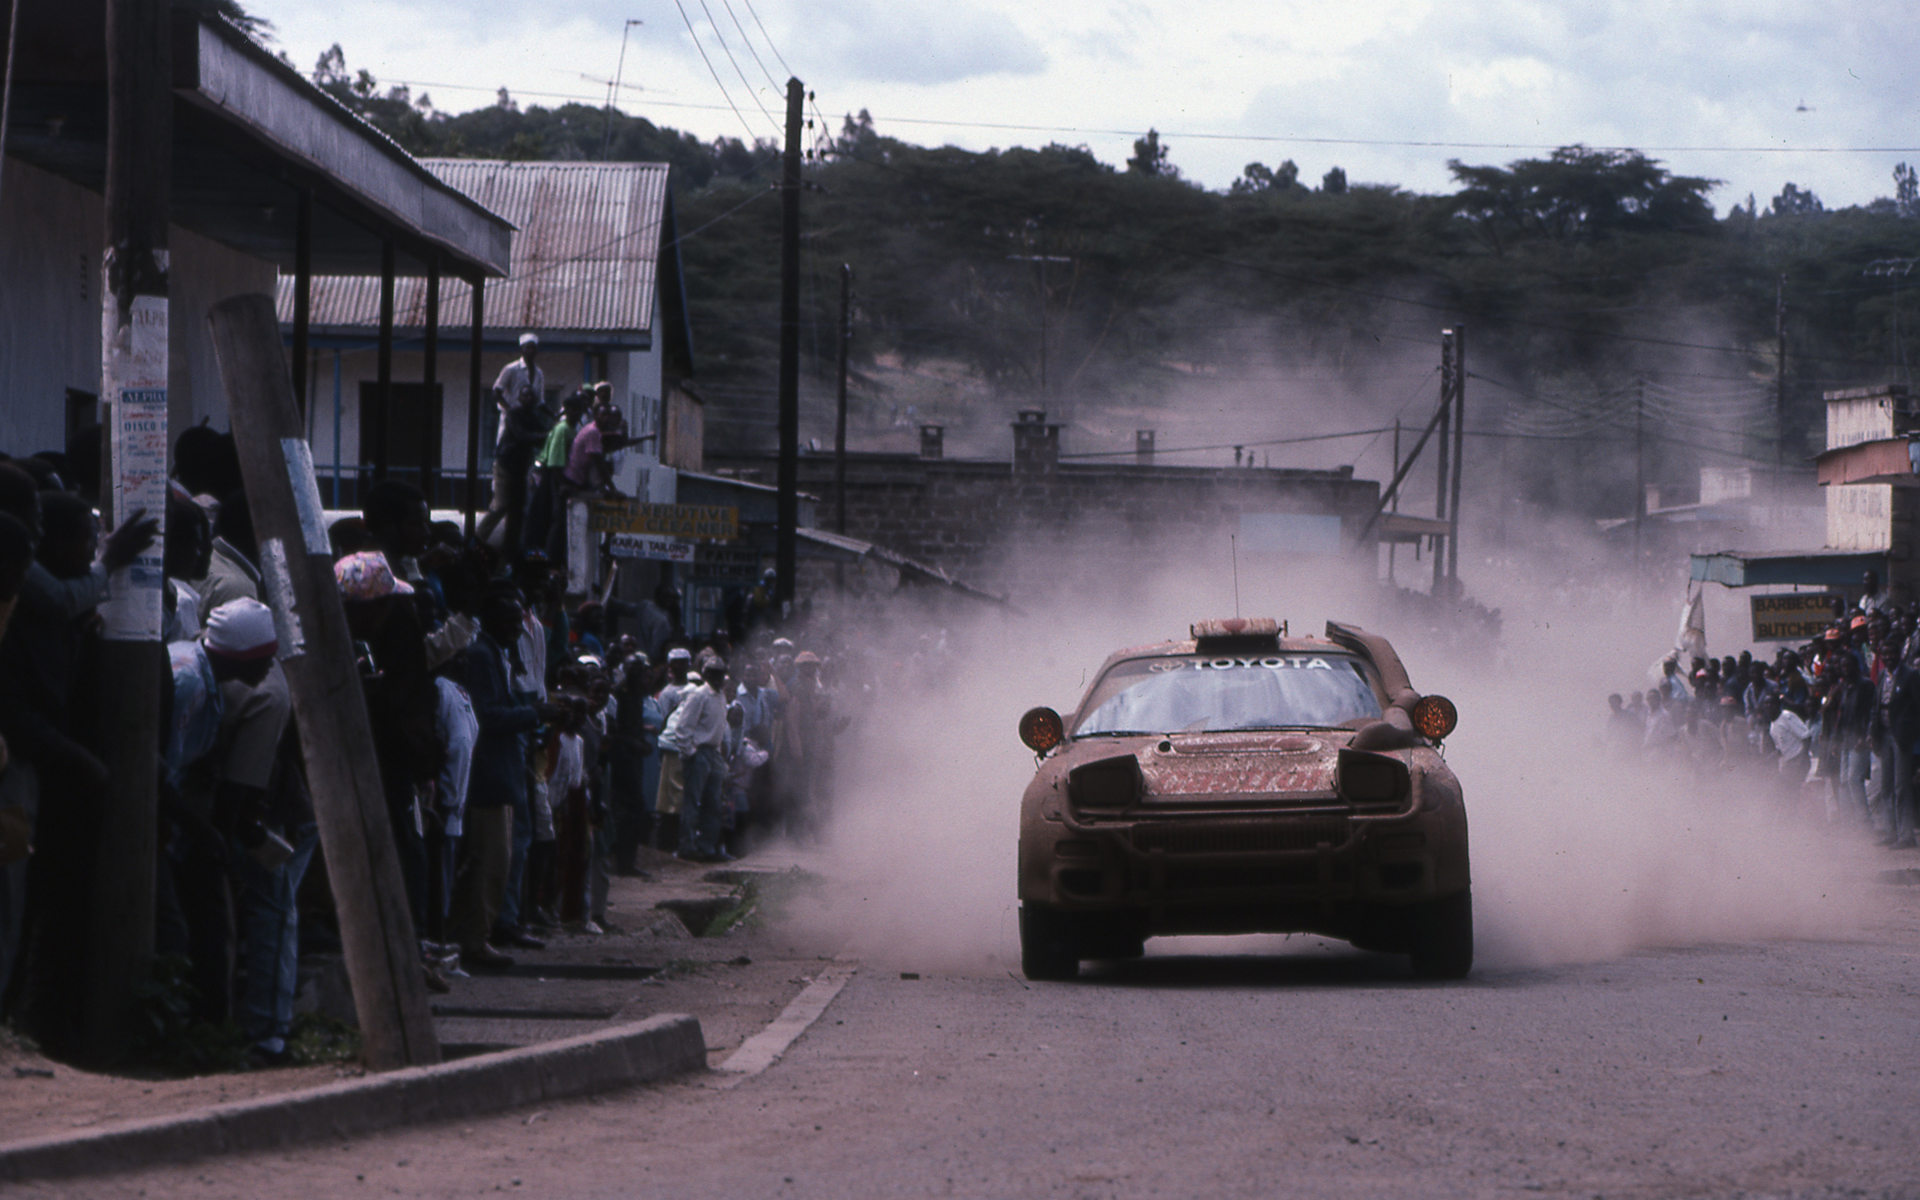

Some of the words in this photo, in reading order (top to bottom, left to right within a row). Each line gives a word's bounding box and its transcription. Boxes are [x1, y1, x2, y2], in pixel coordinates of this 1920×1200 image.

[628, 503, 731, 521] EXECUTIVE
[593, 513, 635, 530] DRY
[1758, 621, 1828, 637] BUTCHER
[1189, 656, 1333, 672] TOYOTA
